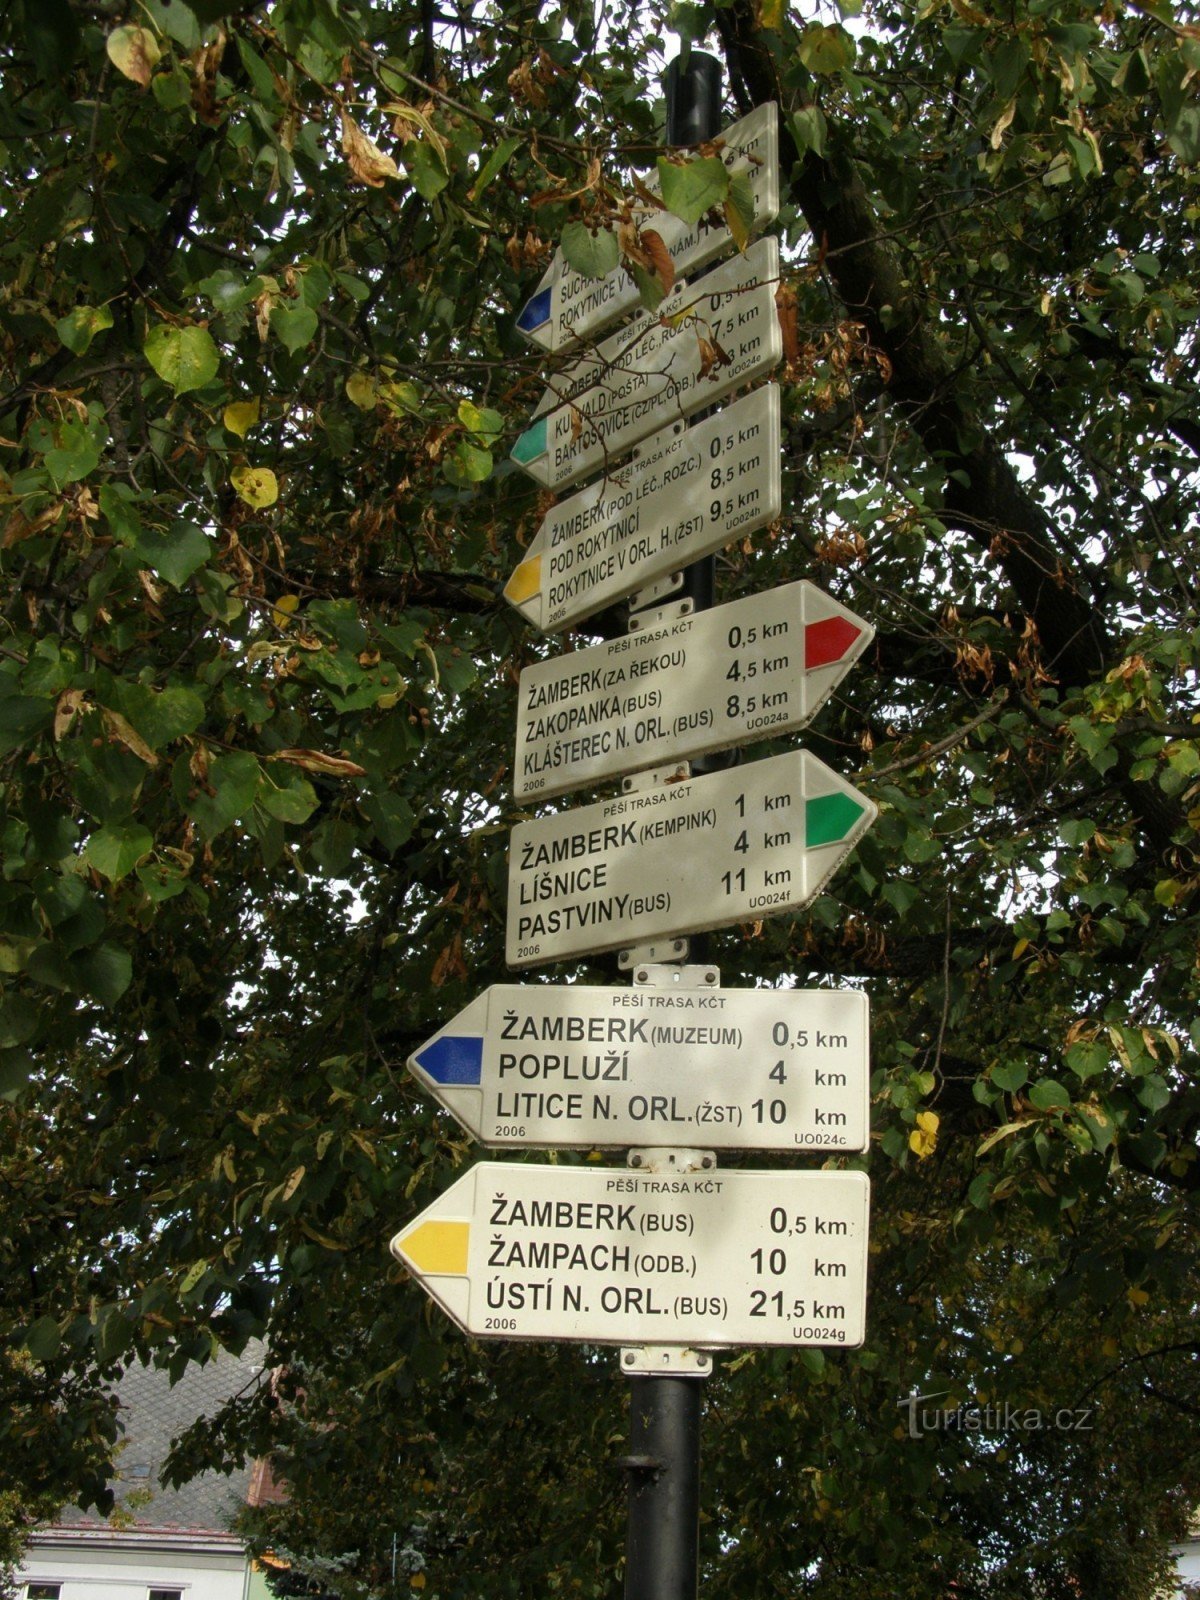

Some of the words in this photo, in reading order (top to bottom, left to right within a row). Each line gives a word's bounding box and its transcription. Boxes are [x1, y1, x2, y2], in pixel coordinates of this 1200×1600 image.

[560, 279, 615, 331] ROKYTNICE
[618, 273, 625, 292] V
[710, 291, 733, 312] 0,5
[737, 275, 758, 296] km
[616, 326, 635, 345] PĚŠÍ
[666, 296, 683, 313] KČT
[740, 336, 761, 357] km
[555, 392, 606, 439] KUVALD
[711, 318, 734, 341] 7,5
[738, 306, 759, 327] km
[554, 465, 573, 481] 2006
[635, 451, 663, 473] TRASA
[665, 439, 683, 455] KČT
[551, 500, 605, 548] ŽAMBERK
[606, 491, 633, 520] (POD
[709, 435, 734, 460] 0,5
[738, 424, 760, 444] km
[550, 552, 574, 579] POD
[576, 507, 640, 569] ROKYTNICÍ
[709, 467, 734, 491] 8,5
[738, 455, 760, 476] km
[548, 607, 567, 624] 2006
[726, 506, 761, 530] UO024h
[549, 554, 615, 609] ROKYTNICE
[617, 553, 626, 572] V
[629, 541, 658, 567] ORL.
[660, 526, 673, 548] H.
[674, 515, 704, 545] (ŽST)
[709, 498, 734, 523] 9,5
[738, 488, 760, 508] km
[608, 640, 631, 655] PĚŠÍ
[635, 629, 668, 647] TRASA
[672, 621, 693, 636] KČT
[527, 668, 601, 710] ŽAMBERK
[603, 670, 626, 690] (ZA
[629, 650, 686, 678] ŘEKOU)
[729, 626, 757, 649] 0,5
[763, 621, 788, 639] km
[526, 696, 621, 743] ZAKOPANKA
[622, 689, 661, 717] (BUS)
[726, 660, 757, 683] 4,5
[763, 655, 788, 674] km
[524, 731, 610, 776] KLÁŠTEREC
[615, 728, 629, 749] N.
[635, 718, 670, 742] ORL.
[673, 709, 713, 737] (BUS)
[726, 695, 757, 718] 8,5
[763, 691, 788, 710] km
[524, 778, 545, 792] 2006
[746, 712, 789, 731] UO024a
[604, 802, 627, 818] PĚŠÍ
[630, 792, 667, 811] TRASA
[670, 786, 692, 802] KČT
[520, 821, 637, 870] ŽAMBERK
[640, 808, 716, 845] (KEMPINK)
[735, 794, 745, 817] 1
[765, 793, 791, 812] km
[520, 864, 607, 905] LÍŠNICE
[734, 830, 749, 854] 4
[765, 831, 791, 849] km
[517, 945, 540, 958] 2006
[749, 891, 791, 908] UO024f
[518, 894, 629, 940] PASTVINY
[628, 892, 671, 920] (BUS)
[721, 868, 746, 895] 11
[765, 869, 791, 887] km
[613, 995, 644, 1007] PĚŠÍ
[648, 997, 694, 1008] TRASA
[698, 997, 726, 1009] KČT
[500, 1010, 649, 1043] ŽAMBERK
[652, 1026, 742, 1049] (MUZEUM)
[772, 1021, 808, 1048] 0,5
[816, 1031, 848, 1048] km
[499, 1051, 629, 1081] POPLUŽÍ
[769, 1060, 787, 1085] 4
[815, 1069, 846, 1086] km
[496, 1092, 582, 1119] LITICE
[593, 1094, 617, 1121] N.
[629, 1096, 693, 1123] ORL.
[695, 1101, 742, 1127] (ŽST)
[751, 1099, 786, 1124] 10
[815, 1108, 846, 1125] km
[495, 1125, 526, 1137] 2006
[794, 1133, 846, 1145] UO024c
[607, 1180, 638, 1193] PĚŠÍ
[642, 1181, 690, 1194] TRASA
[694, 1180, 723, 1194] KČT
[490, 1193, 636, 1231] ŽAMBERK
[640, 1212, 694, 1236] (BUS)
[769, 1207, 806, 1236] 0,5
[815, 1217, 847, 1235] km
[488, 1234, 630, 1272] ŽAMPACH
[634, 1254, 696, 1277] (ODB.)
[750, 1248, 786, 1275] 10
[815, 1259, 846, 1277] km
[487, 1276, 552, 1310] ÚSTÍ
[563, 1285, 590, 1313] N.
[601, 1287, 669, 1315] ORL.
[674, 1296, 728, 1320] (BUS)
[749, 1290, 805, 1320] 21,5
[813, 1301, 845, 1319] km
[485, 1318, 517, 1330] 2006
[793, 1327, 845, 1342] UO024g
